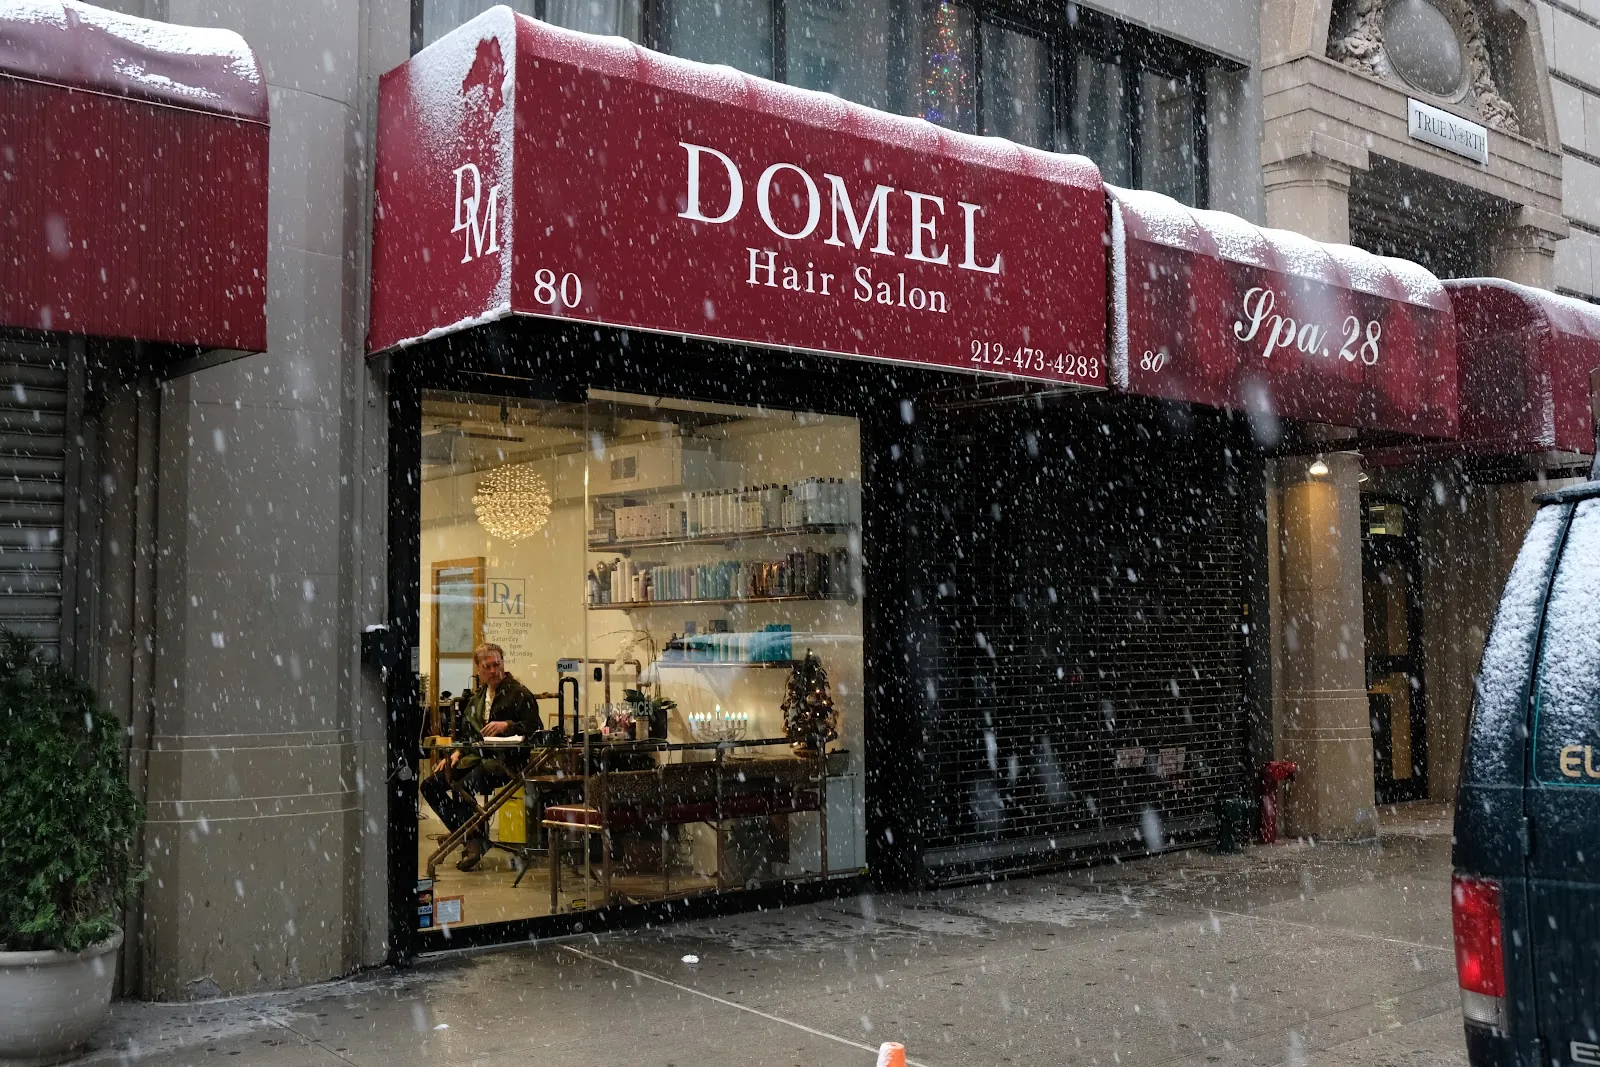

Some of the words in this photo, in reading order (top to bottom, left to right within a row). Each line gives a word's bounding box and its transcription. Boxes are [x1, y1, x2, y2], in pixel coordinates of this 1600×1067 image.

[677, 142, 1000, 274] DOMEL
[534, 268, 582, 308] 80
[746, 247, 835, 296] Hair
[854, 266, 948, 313] Salon
[970, 339, 1100, 379] 212-473-4283
[1338, 315, 1382, 365] 28
[1139, 350, 1165, 373] 80
[492, 635, 519, 643] Saturday
[514, 621, 533, 629] Friday
